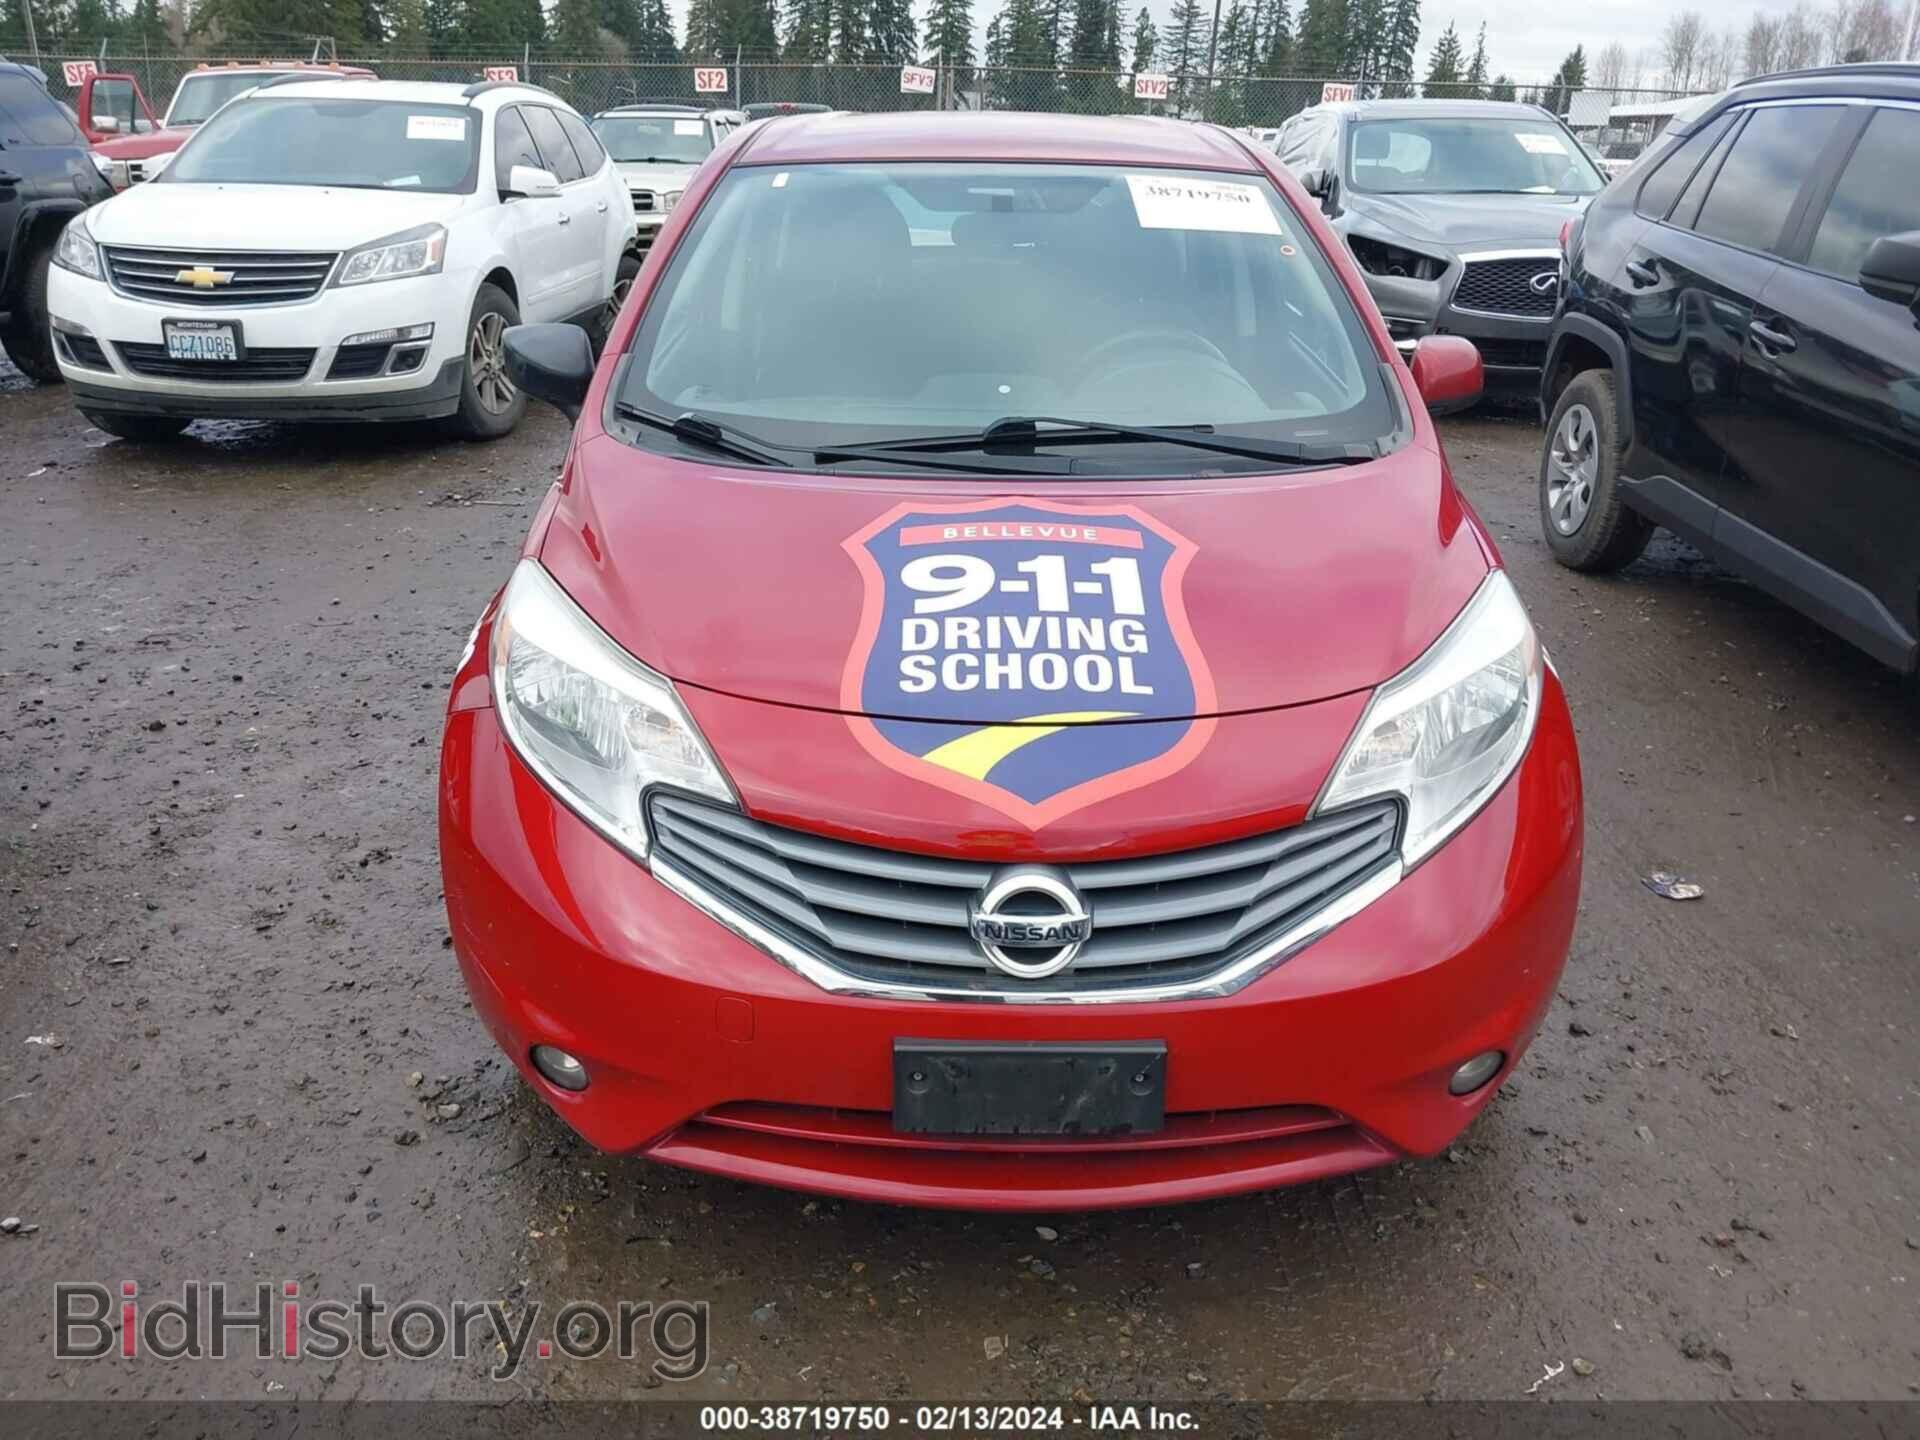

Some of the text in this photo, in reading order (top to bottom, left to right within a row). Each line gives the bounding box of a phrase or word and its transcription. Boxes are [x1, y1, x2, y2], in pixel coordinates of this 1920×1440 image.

[697, 71, 725, 89] SF2
[903, 71, 934, 88] SFV3
[1136, 79, 1166, 95] SFV2
[942, 526, 1099, 541] BELLEVUE
[900, 554, 1146, 617] 9-1-1
[901, 616, 1149, 654] DRIVING
[899, 653, 1154, 695] SCHOOL
[984, 923, 1079, 941] NISSAN
